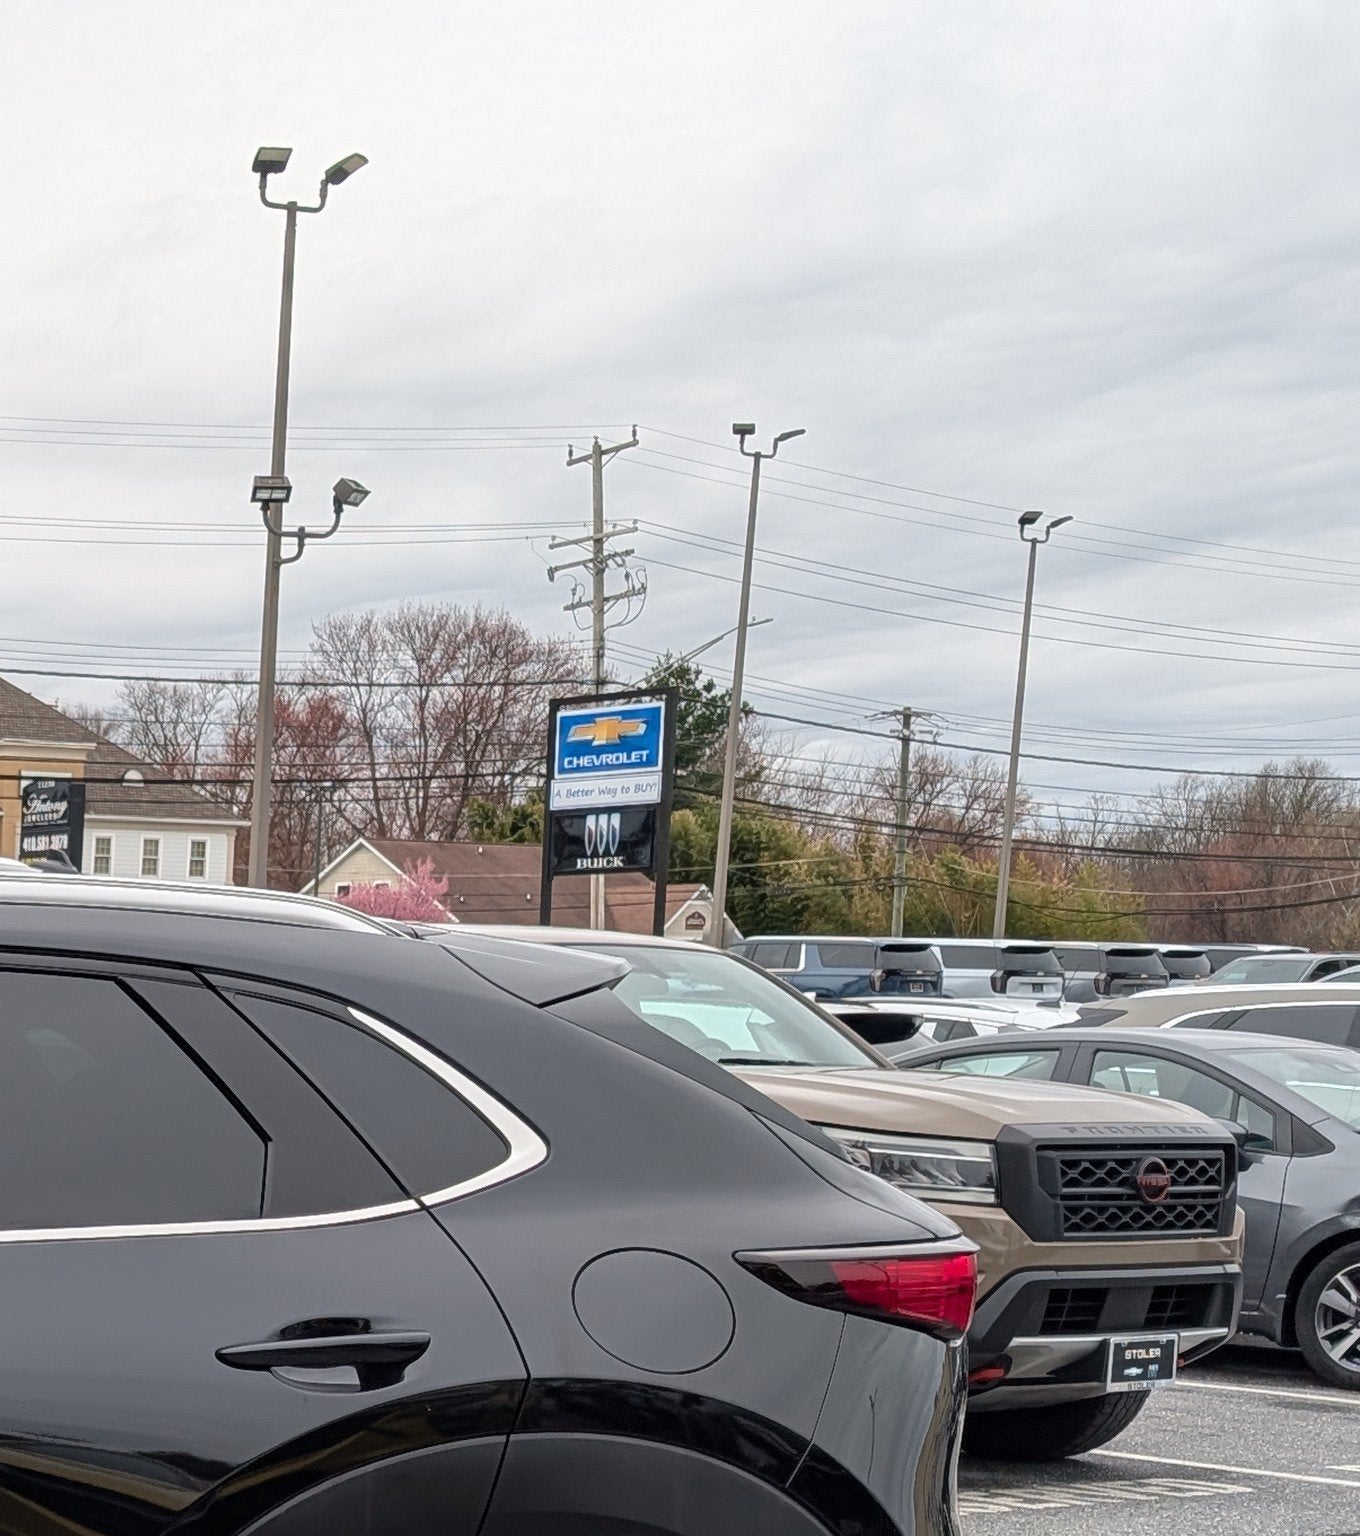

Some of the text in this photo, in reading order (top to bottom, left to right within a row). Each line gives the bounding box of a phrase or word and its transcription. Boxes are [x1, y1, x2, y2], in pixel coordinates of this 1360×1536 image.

[563, 750, 650, 769] CHEVROLET
[554, 790, 562, 798] A
[566, 788, 595, 798] Better
[598, 785, 618, 798] Way
[621, 784, 631, 794] to
[576, 856, 625, 869] BUICK
[1061, 1126, 1209, 1135] FRONTIER
[1124, 1347, 1161, 1360] STOLER
